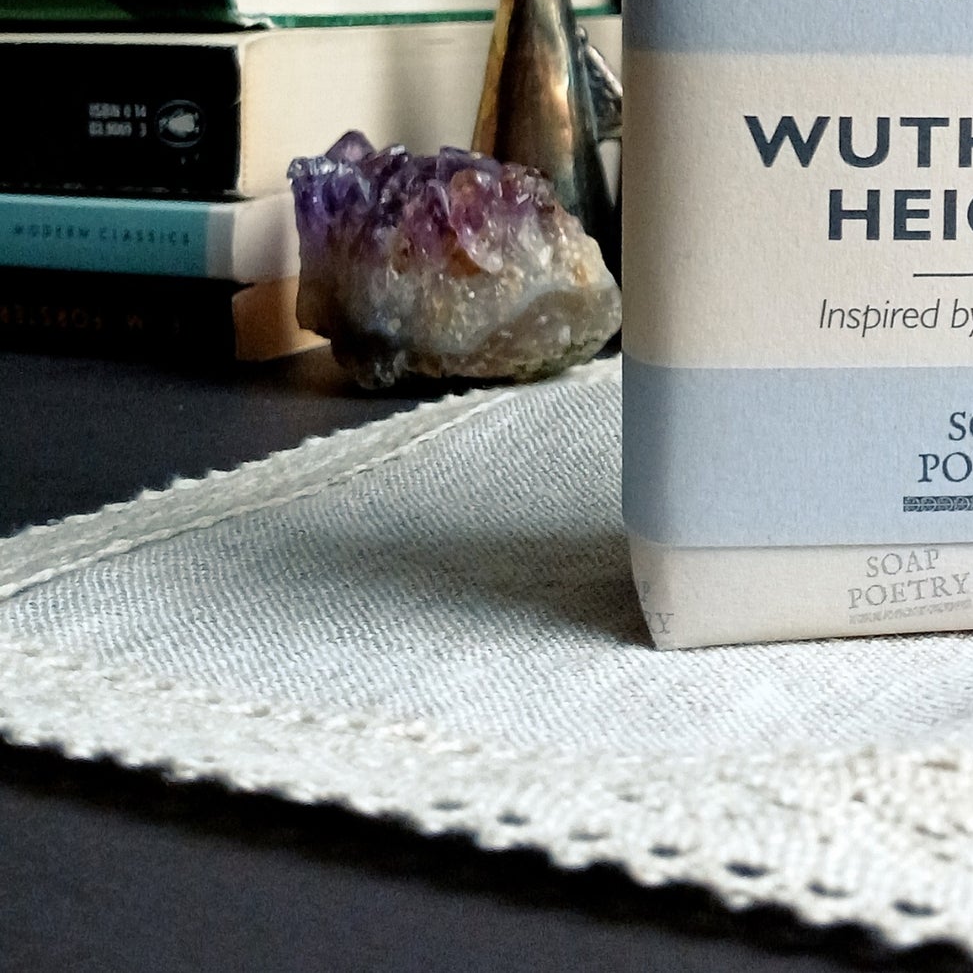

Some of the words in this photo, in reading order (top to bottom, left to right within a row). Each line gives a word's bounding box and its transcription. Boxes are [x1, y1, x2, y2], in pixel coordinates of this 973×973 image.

[820, 299, 940, 338] Inspired
[865, 548, 939, 578] SOAP
[847, 572, 970, 609] POETRY
